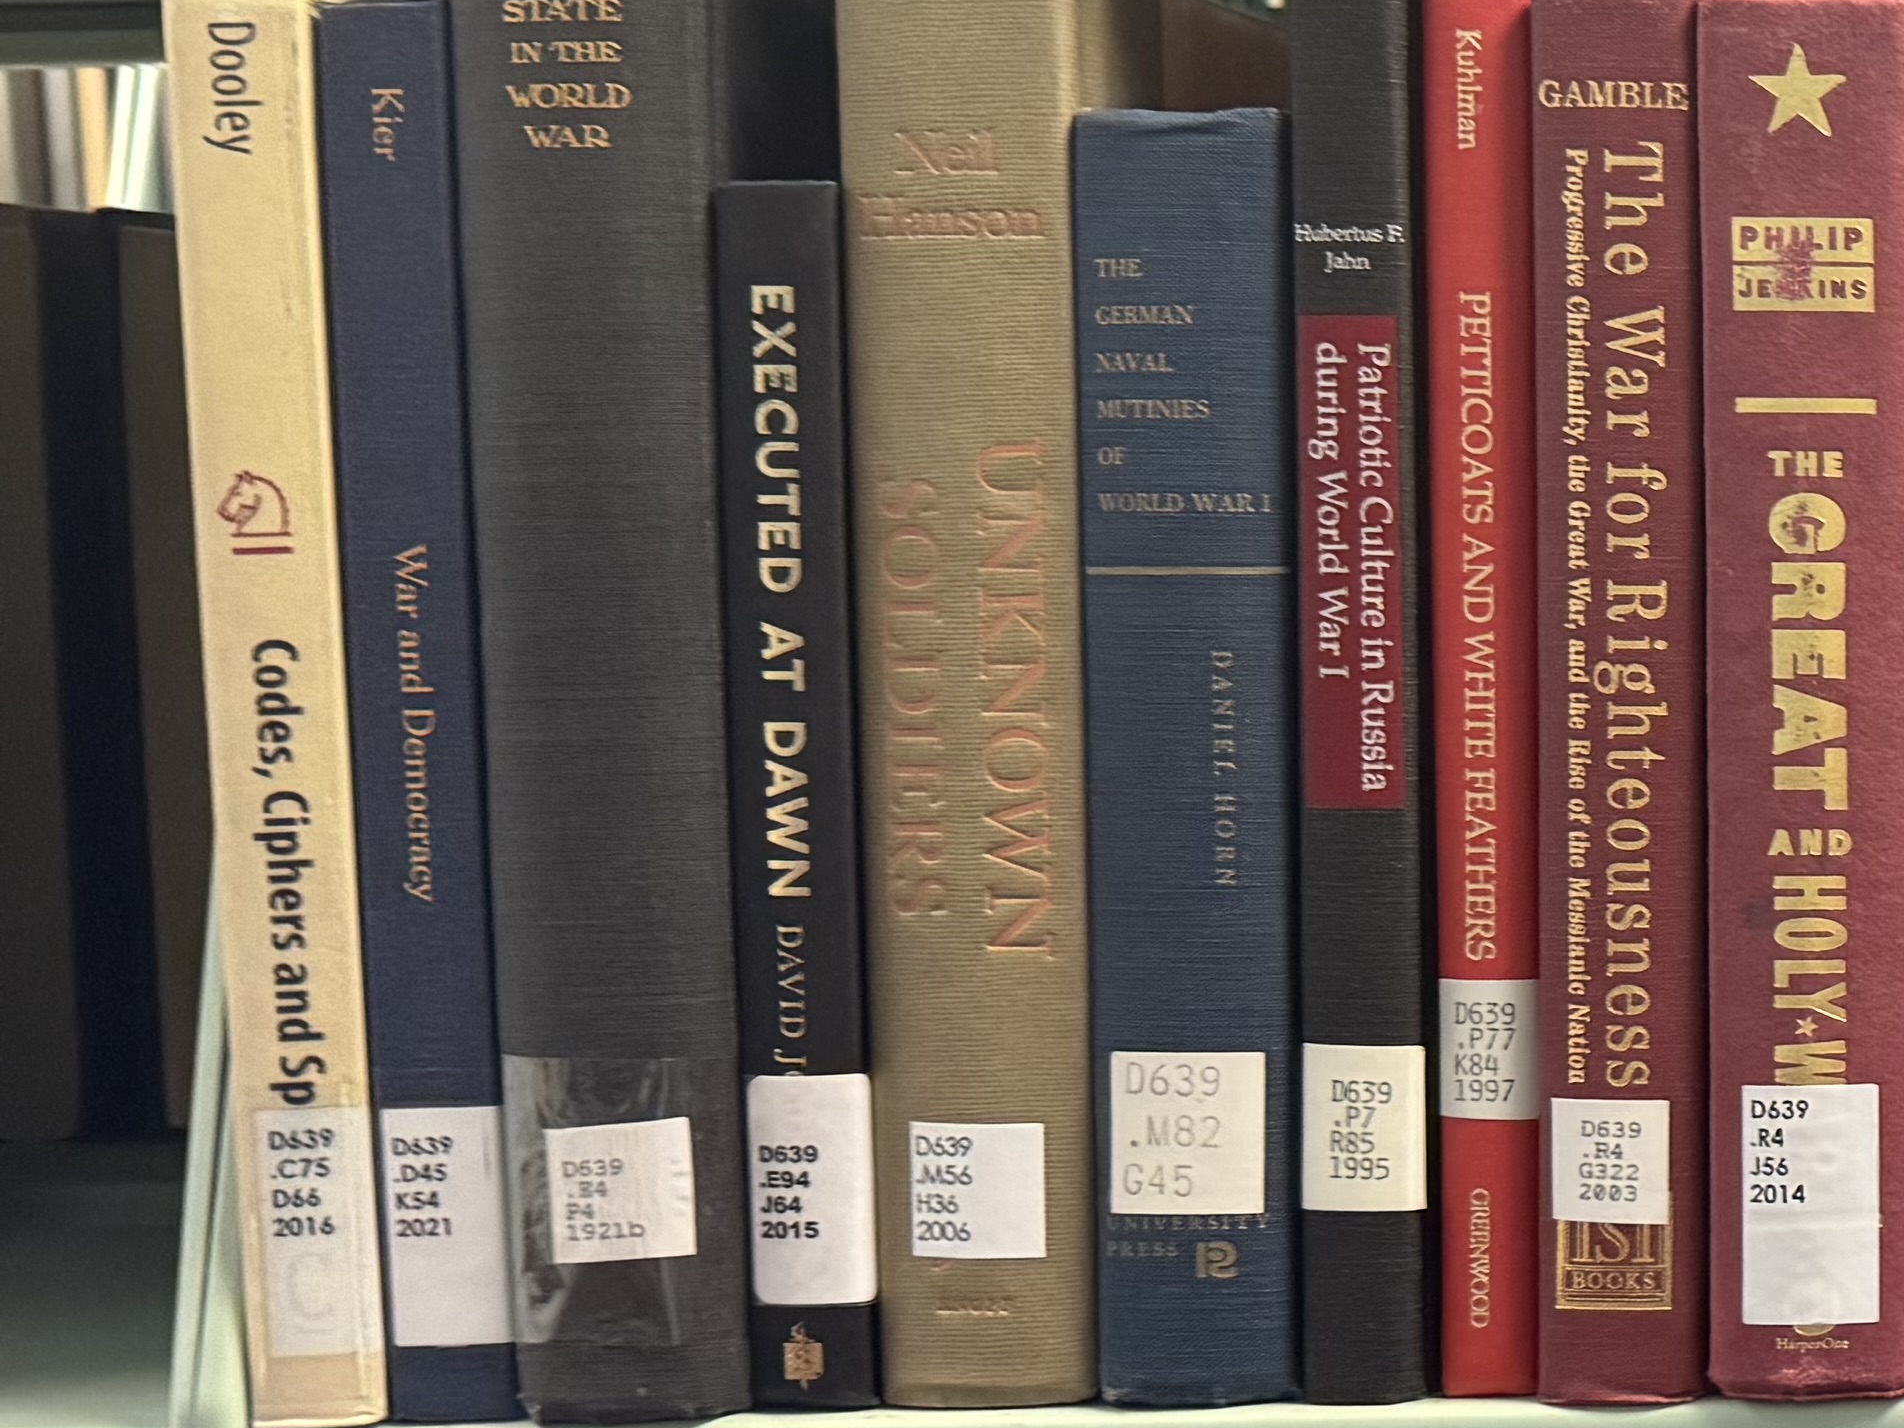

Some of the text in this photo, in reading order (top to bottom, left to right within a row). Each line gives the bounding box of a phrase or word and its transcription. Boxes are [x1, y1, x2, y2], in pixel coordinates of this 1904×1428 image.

[202, 21, 255, 155] Dooley
[506, 84, 631, 109] WORLD
[510, 41, 622, 64] IN THE
[1457, 29, 1481, 150] Kuhlman
[1538, 80, 1688, 112] GAMBLE
[524, 126, 610, 149] WAR
[1740, 226, 1865, 251] PHILIP
[1308, 343, 1350, 656] during World War
[1356, 342, 1392, 629] Patriotic Culture
[1460, 291, 1495, 623] PETTICOATS AND
[1768, 450, 1844, 477] THE
[751, 284, 812, 898] EXECUTED AT DAWN
[1593, 141, 1669, 1088] The War for Righteousness
[252, 639, 316, 1043] Codes, Ciphers and
[1769, 830, 1852, 856] AND
[1772, 877, 1848, 1023] HOLY
